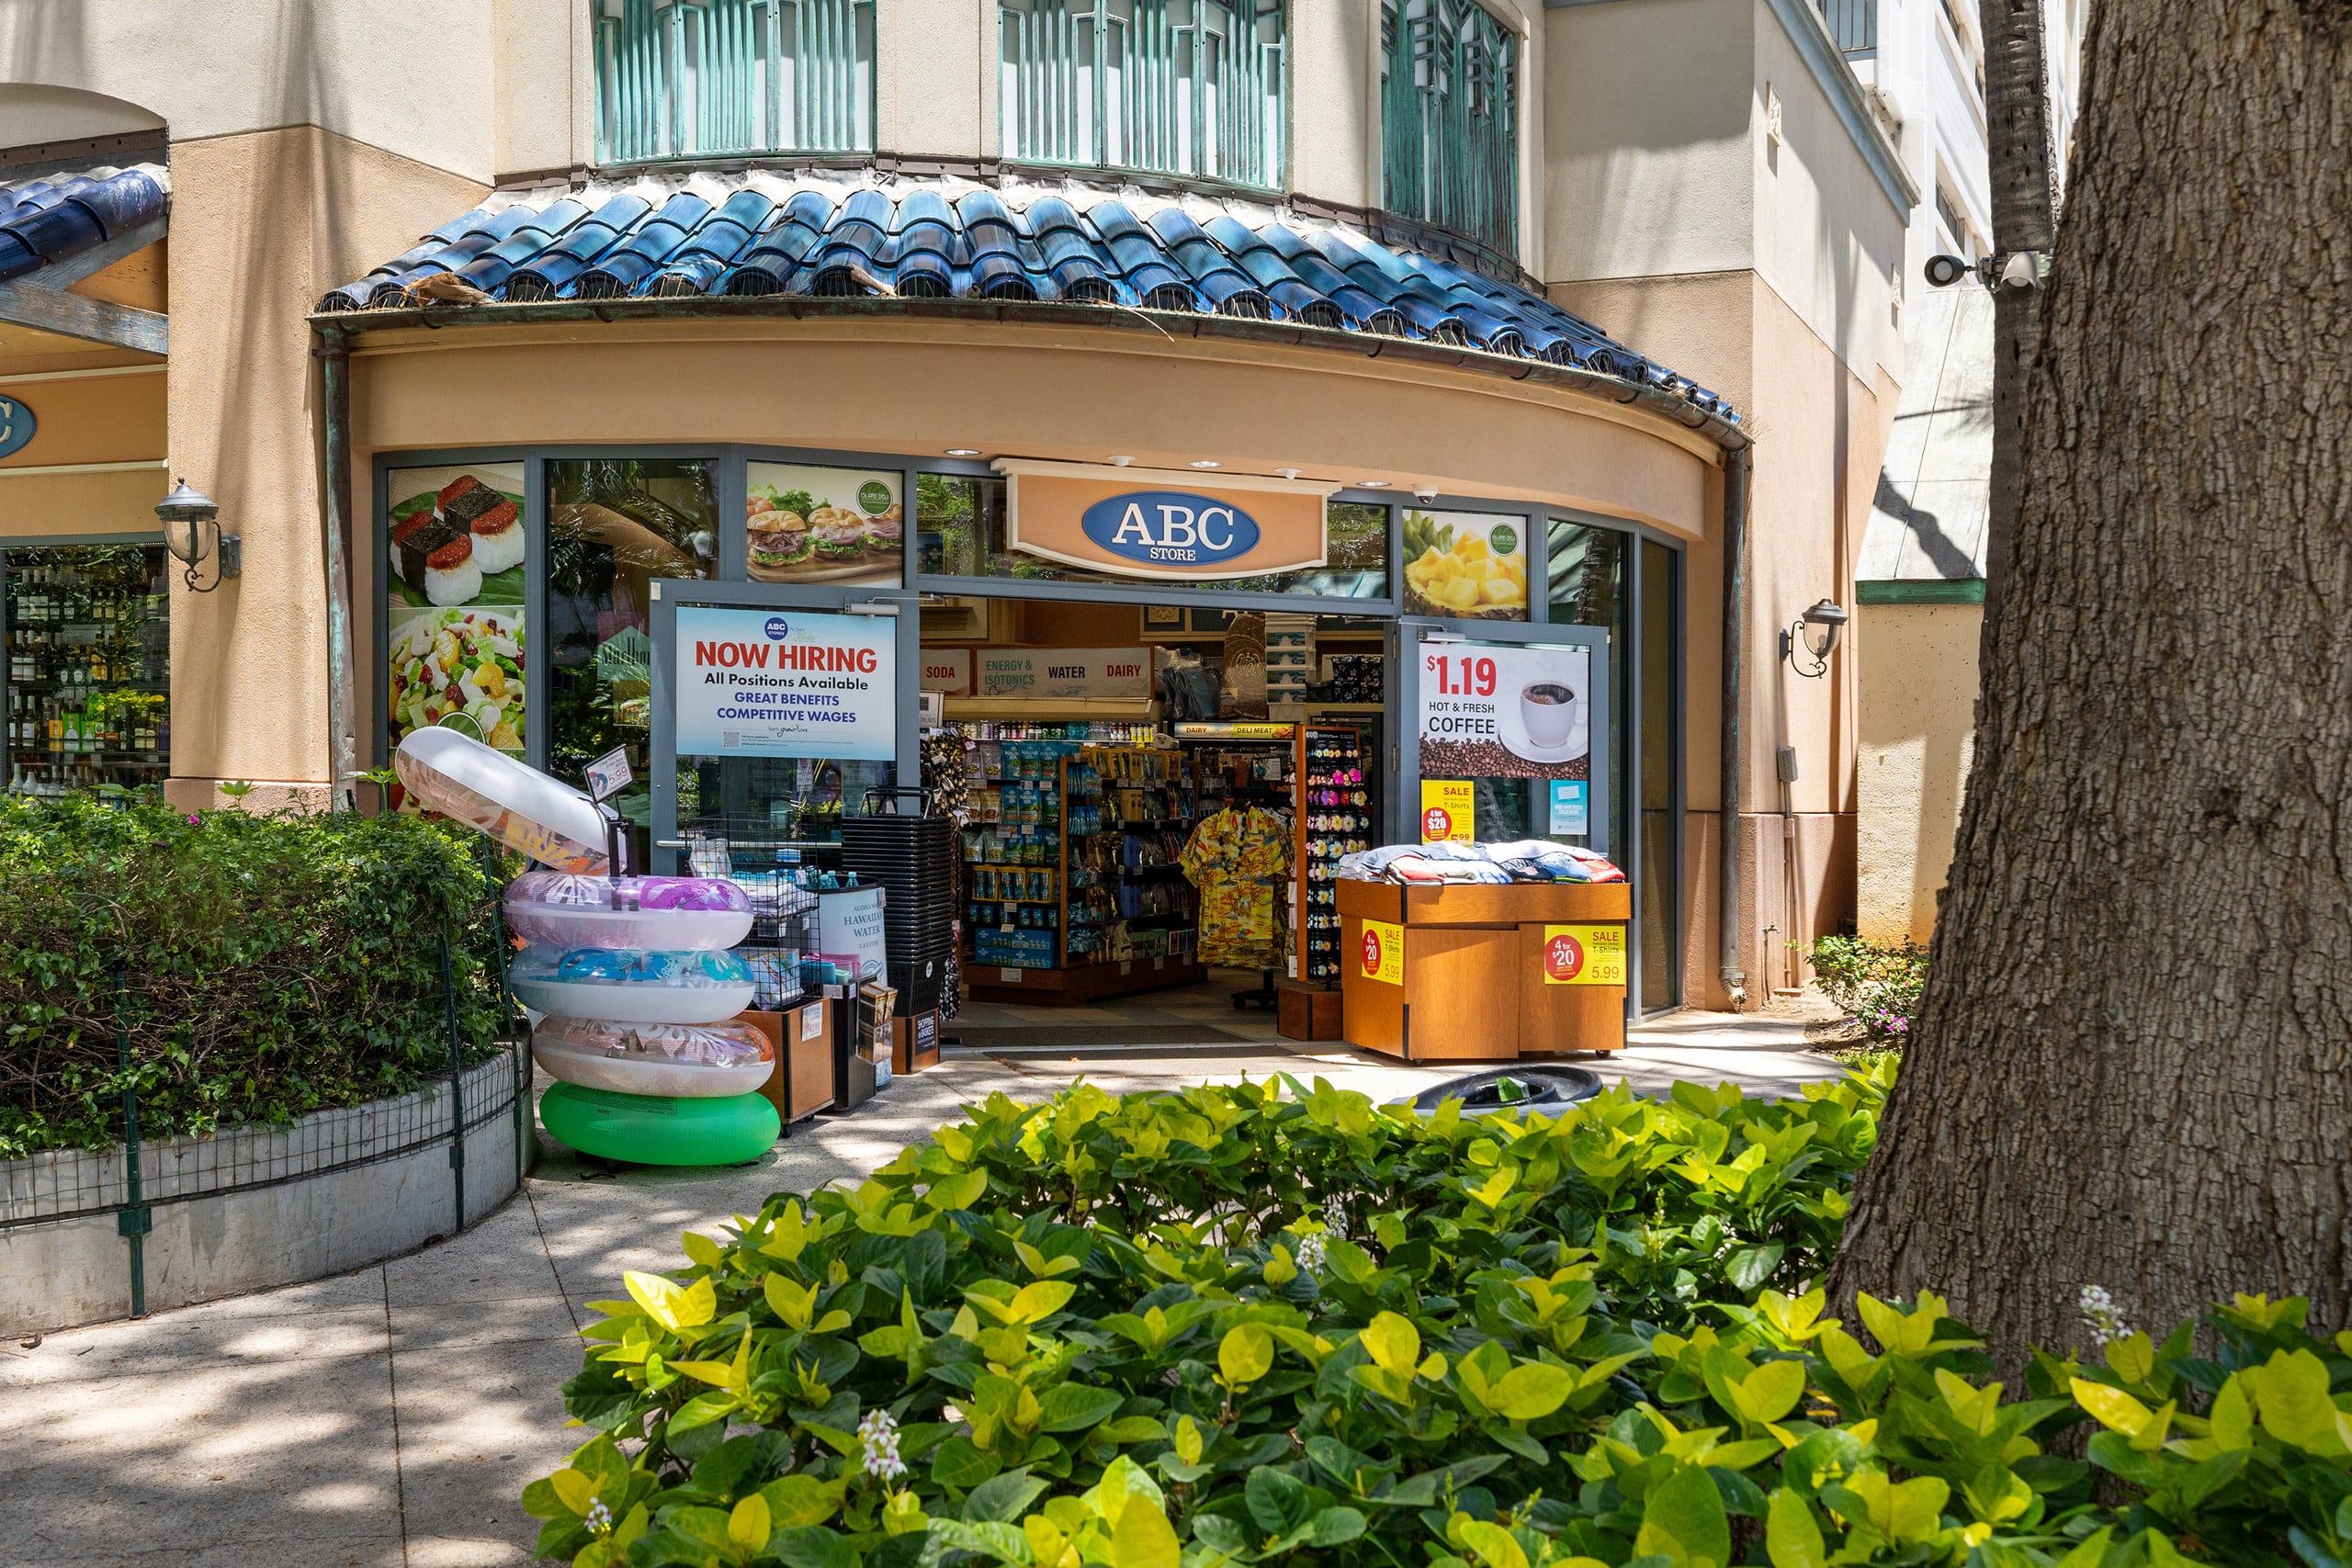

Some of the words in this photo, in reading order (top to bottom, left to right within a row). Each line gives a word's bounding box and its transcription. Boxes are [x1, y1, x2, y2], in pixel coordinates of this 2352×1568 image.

[1112, 502, 1234, 551] ABC
[1149, 547, 1196, 561] STORE
[767, 623, 786, 631] ABC
[695, 640, 770, 670] NOW
[778, 645, 877, 673] HIRING
[986, 660, 1023, 671] ENERGY
[1025, 660, 1033, 671] &
[1107, 664, 1141, 677] DAIRY
[926, 666, 956, 679] SODA
[1048, 666, 1086, 679] WATER
[1427, 655, 1497, 696] $1.19
[704, 672, 724, 685] All
[729, 673, 795, 688] Positions
[798, 676, 868, 690] Available
[985, 674, 1035, 686] ISOTONICS
[735, 692, 778, 705] GREAT
[781, 694, 840, 706] BENEFITS
[1429, 702, 1450, 712] HOT
[1453, 703, 1460, 712] &
[1463, 703, 1495, 713] FRESH
[717, 707, 804, 721] COMPETITIVE
[807, 710, 856, 723] WAGES
[1429, 716, 1495, 734] COFFEE
[1443, 786, 1470, 795] SALE
[1427, 817, 1447, 830] $20
[843, 910, 883, 926] HAWAIIAN
[853, 925, 880, 937] WATER
[1385, 929, 1400, 942] SALE
[1592, 931, 1619, 942] SALE
[1555, 940, 1561, 950] 4
[1365, 944, 1377, 961] $20
[1552, 950, 1575, 966] $20
[1385, 964, 1399, 979] 5.99
[1591, 965, 1620, 979] 5.99
